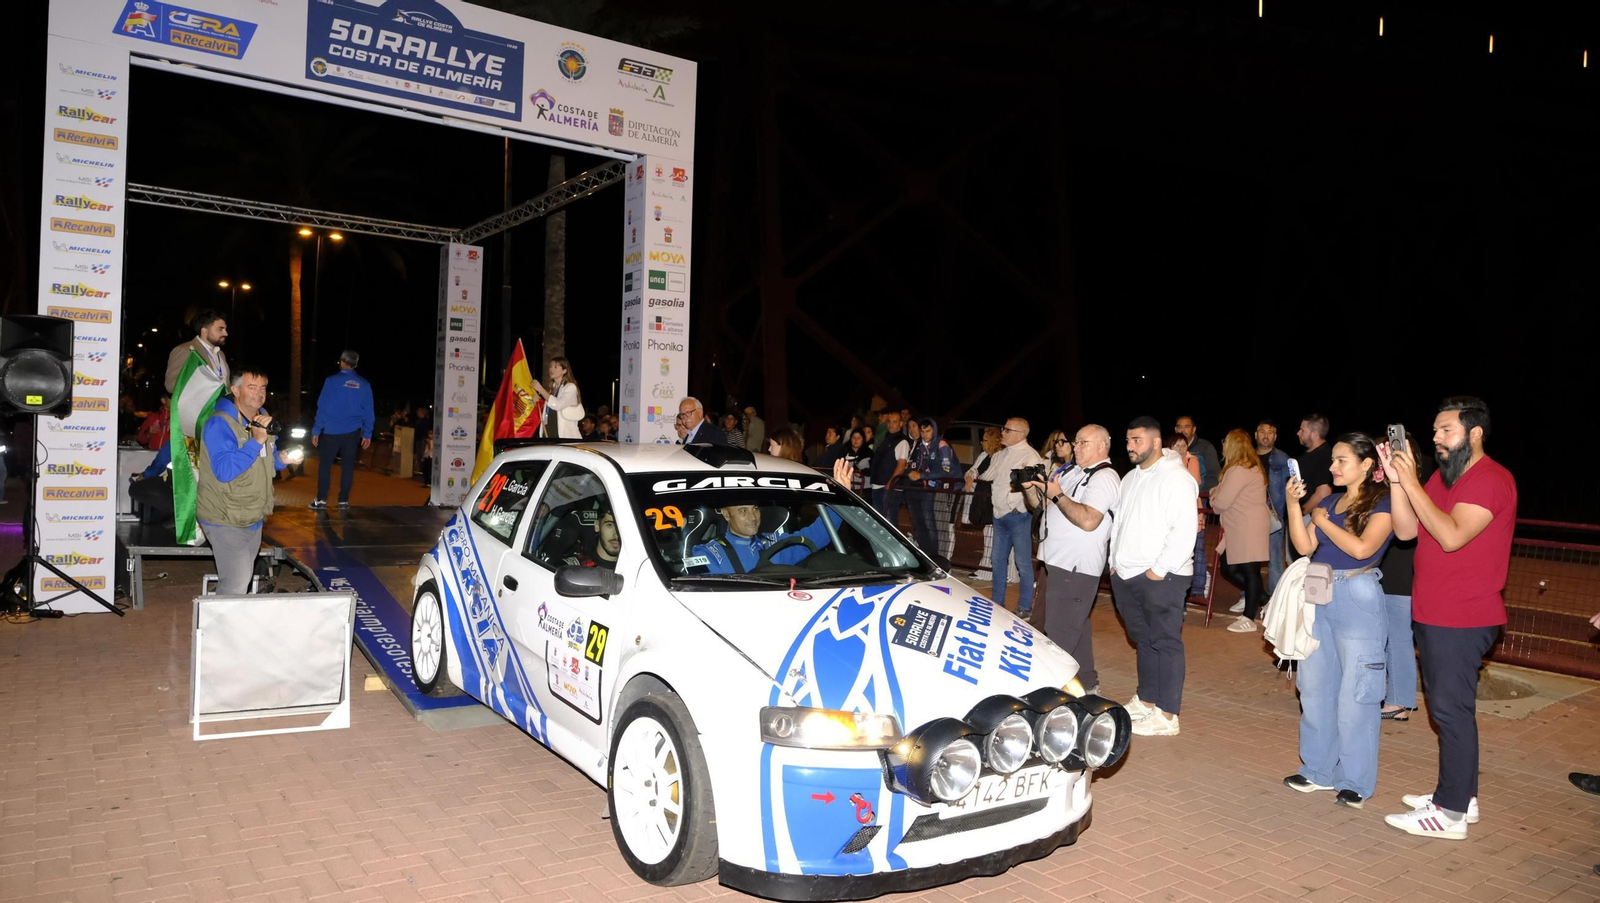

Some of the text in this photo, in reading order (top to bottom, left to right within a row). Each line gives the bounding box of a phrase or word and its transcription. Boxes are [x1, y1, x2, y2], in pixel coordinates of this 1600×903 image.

[168, 10, 240, 37] CERA
[410, 15, 453, 30] RALLYE COSTA
[181, 33, 226, 52] Recalvi
[329, 18, 506, 77] 50 RALLYE
[75, 69, 117, 81] MICHELIN
[328, 43, 503, 92] COSTA DE ALMERÍA
[58, 105, 117, 125] Rallycar
[557, 104, 599, 120] COSTA DE
[548, 112, 599, 132] ALMERÍA
[628, 120, 681, 139] DIPUTACIÓN
[66, 132, 106, 146] Recalvi
[628, 130, 678, 148] DE ALMERÍA
[72, 158, 114, 168] MICHELIN
[55, 194, 114, 212] Rallycar
[63, 221, 103, 233] Recalvi
[68, 245, 111, 255] MICHELIN
[52, 283, 110, 299] Rallycar
[648, 297, 685, 309] gasolia
[60, 309, 99, 321] Recalvi
[449, 335, 476, 344] gasolia
[647, 338, 684, 352] Phonika
[72, 399, 96, 409] calvi
[47, 463, 106, 476] Rallycar
[652, 476, 832, 493] GARCIA
[55, 489, 95, 498] Recalvi
[477, 473, 508, 513] 29
[645, 505, 684, 531] 29
[45, 554, 104, 567] Rallycar
[547, 615, 565, 629] COSTA DE
[905, 609, 929, 646] 50 RALLYE
[585, 624, 607, 663] 29
[943, 596, 994, 685] Fiat Punto
[999, 620, 1034, 682] Kit Car
[1014, 771, 1052, 798] BFK
